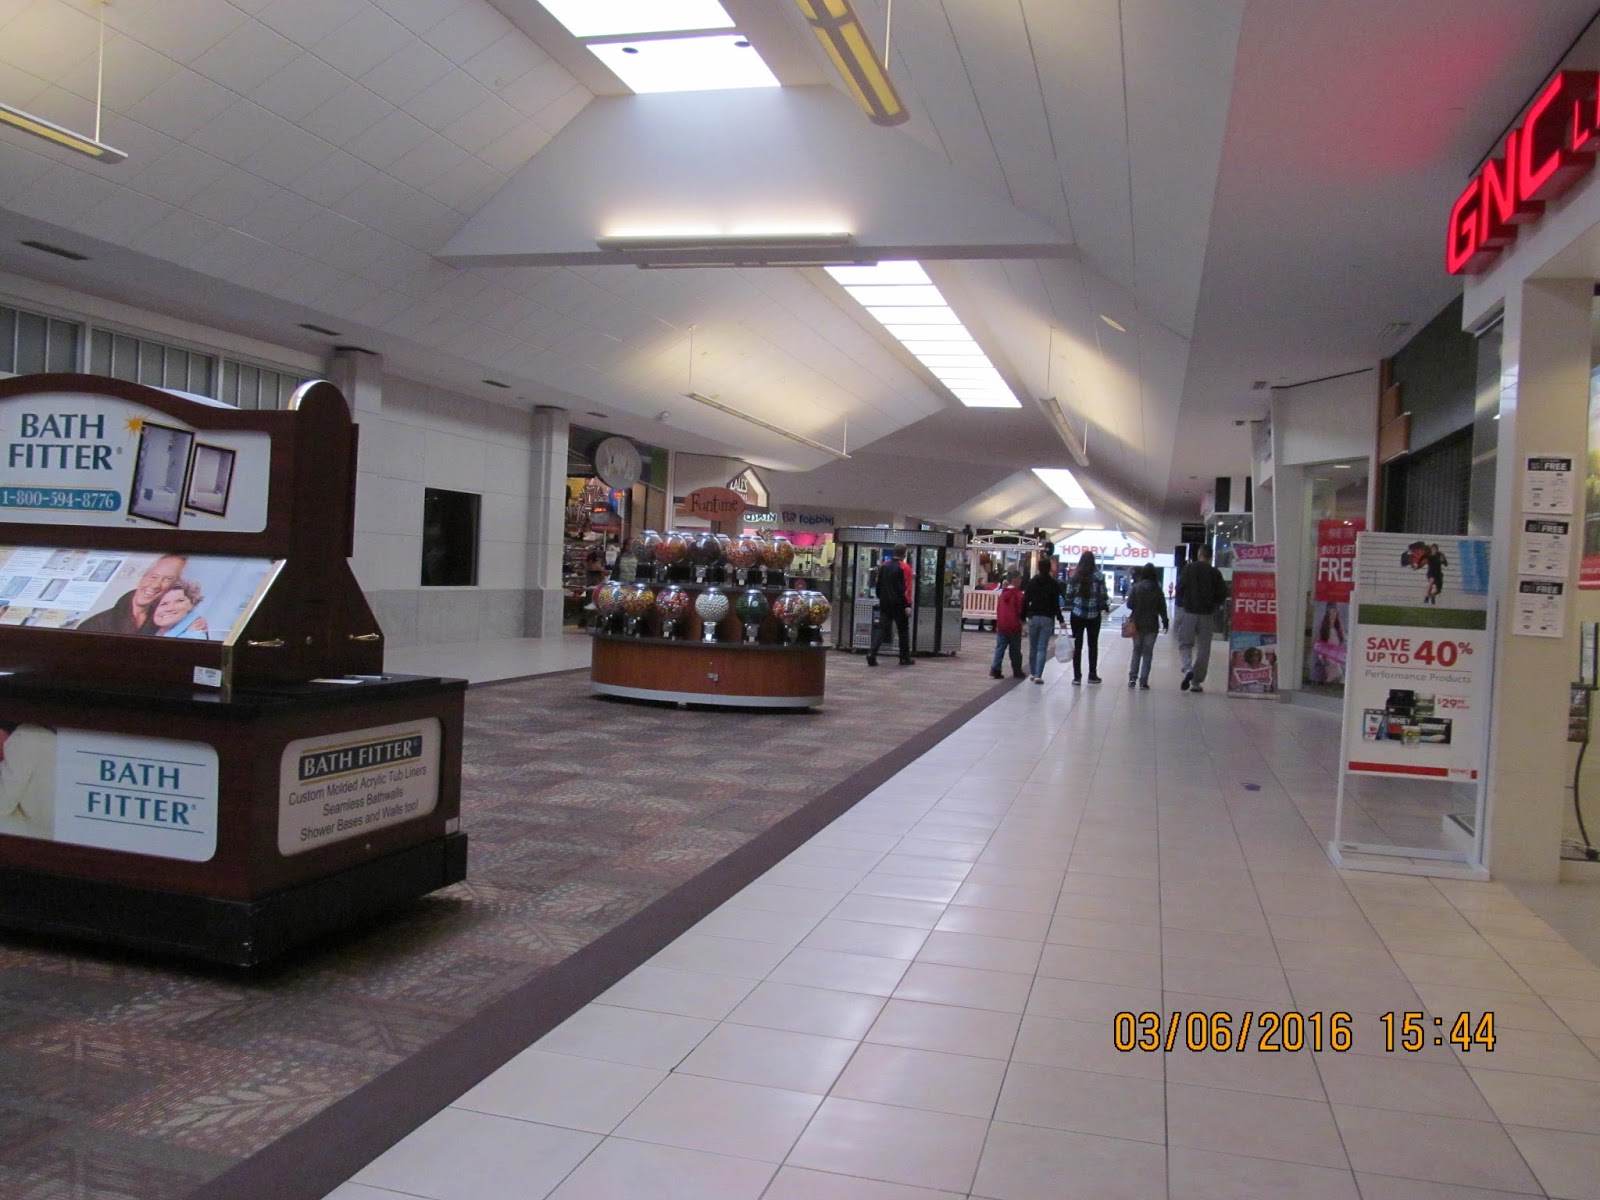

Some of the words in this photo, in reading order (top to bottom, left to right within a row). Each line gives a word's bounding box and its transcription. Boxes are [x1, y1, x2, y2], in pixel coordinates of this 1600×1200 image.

[1446, 70, 1563, 275] GNC
[20, 413, 105, 439] BATH
[8, 443, 113, 471] FITTER
[1544, 462, 1568, 470] FREE
[2, 488, 115, 509] 1-800-594-8776
[691, 493, 739, 513] Funtime
[1541, 525, 1565, 534] FREE
[1062, 545, 1107, 556] HOBBY
[1114, 546, 1157, 559] LOBBY
[1535, 585, 1559, 594] FREE
[1235, 599, 1277, 614] FREE
[1366, 637, 1411, 652] SAVE
[1413, 640, 1474, 668] 40%
[1366, 651, 1387, 663] UP
[1389, 652, 1410, 664] TO
[1365, 669, 1427, 682] Performance
[1429, 673, 1472, 684] Products
[304, 750, 353, 777] BATH
[358, 740, 412, 765] FITTER
[100, 758, 181, 790] BATH
[288, 789, 325, 806] Custom
[327, 780, 358, 797] Molded
[359, 774, 387, 790] Acrylic
[389, 770, 403, 782] Tub
[405, 765, 427, 779] Liners
[87, 791, 190, 826] FITTER
[323, 798, 365, 816] Seamless
[367, 787, 404, 806] Bathwalls
[300, 823, 335, 841] Shower
[337, 815, 363, 832] Bases
[365, 809, 380, 823] and
[382, 806, 403, 819] Walls
[405, 799, 419, 813] too!
